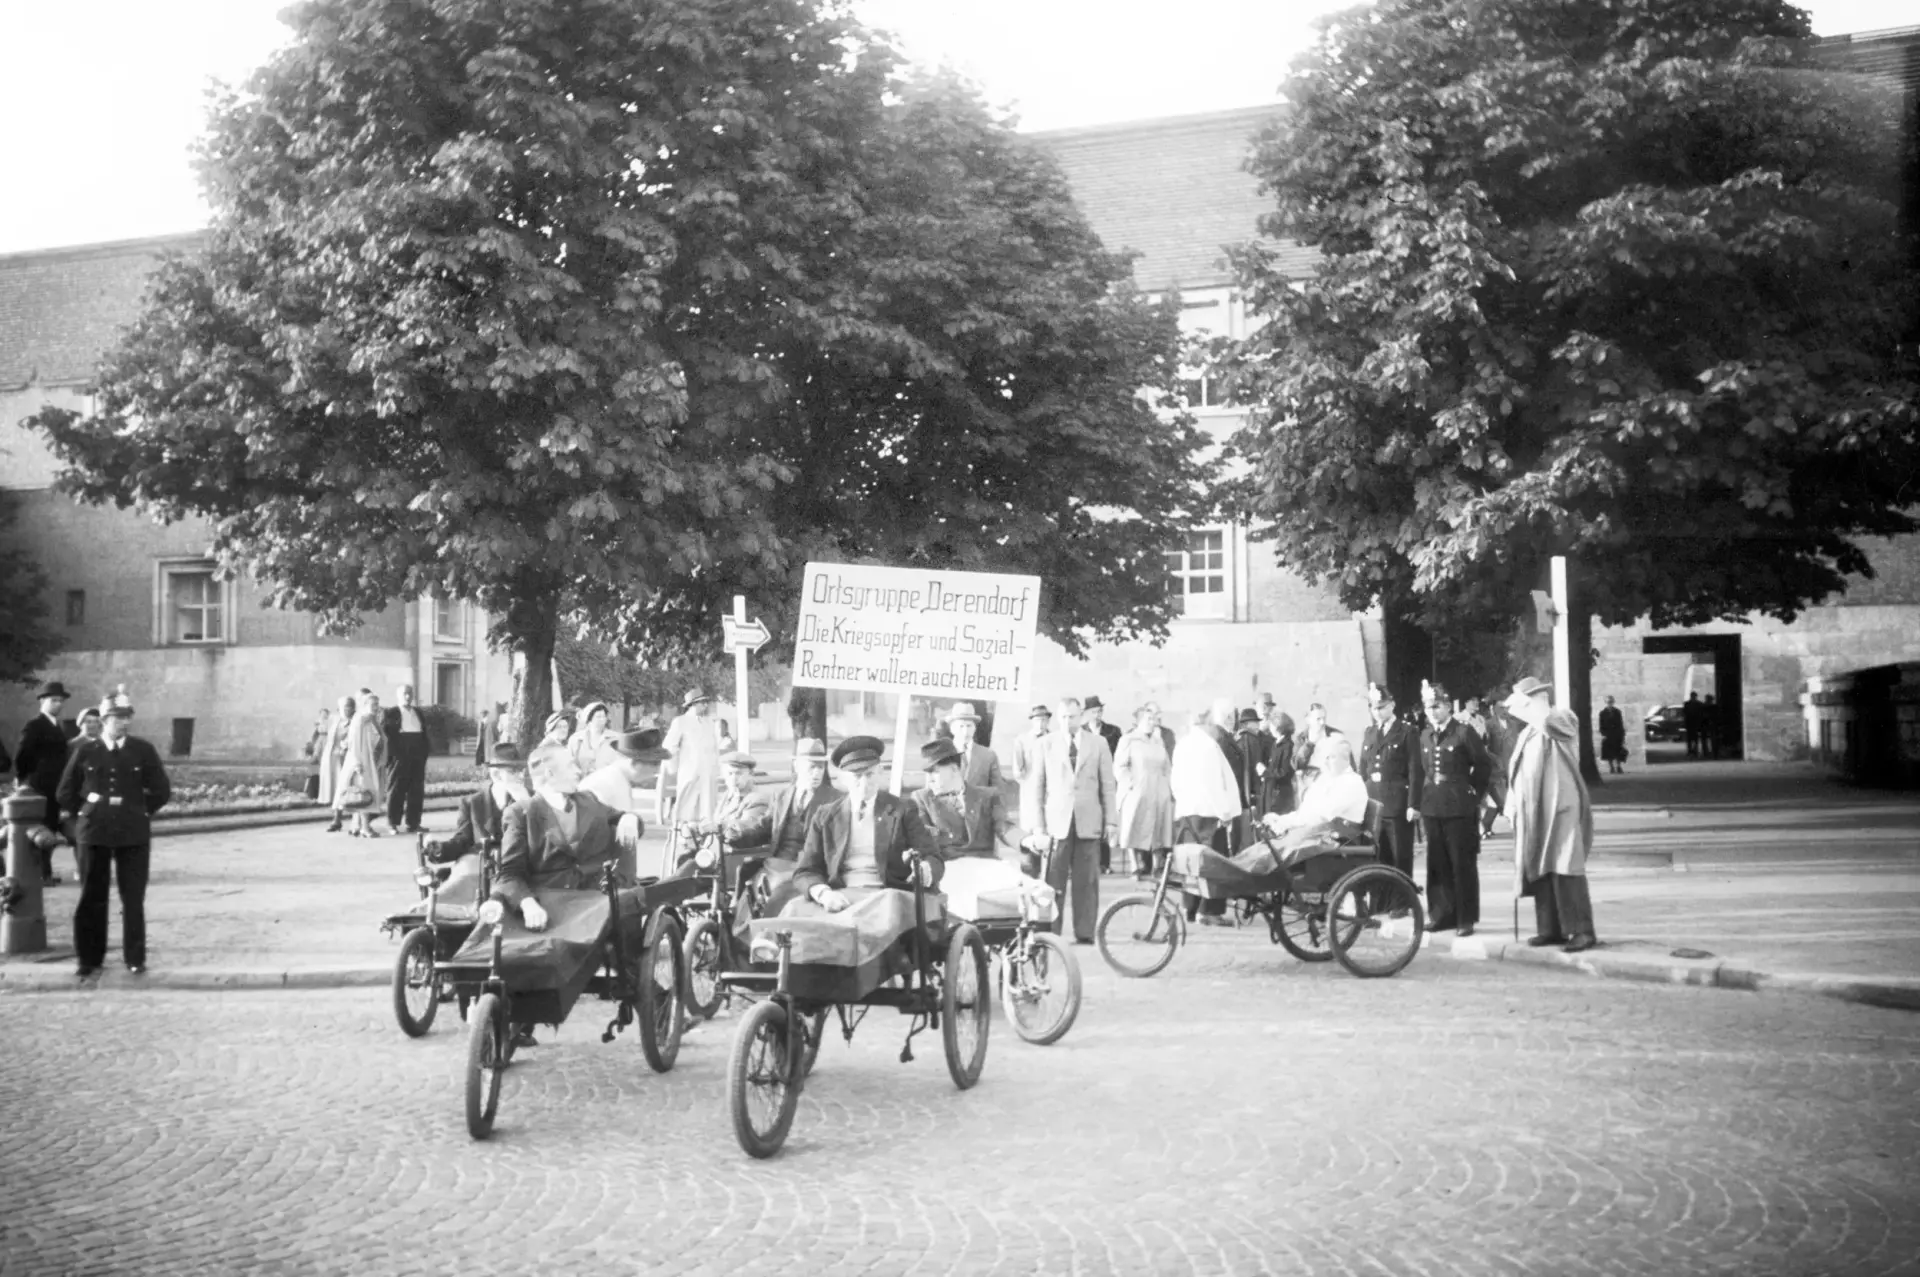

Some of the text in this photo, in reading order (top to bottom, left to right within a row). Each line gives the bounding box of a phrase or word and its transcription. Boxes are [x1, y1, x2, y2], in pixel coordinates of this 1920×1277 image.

[813, 573, 1031, 621] Ortsgruppe Derendorf
[801, 614, 829, 643] Die
[831, 616, 924, 654] Kriegsopfer
[929, 626, 958, 652] und
[801, 649, 863, 681] Rentner
[867, 657, 918, 686] wollen
[921, 662, 959, 688] auch
